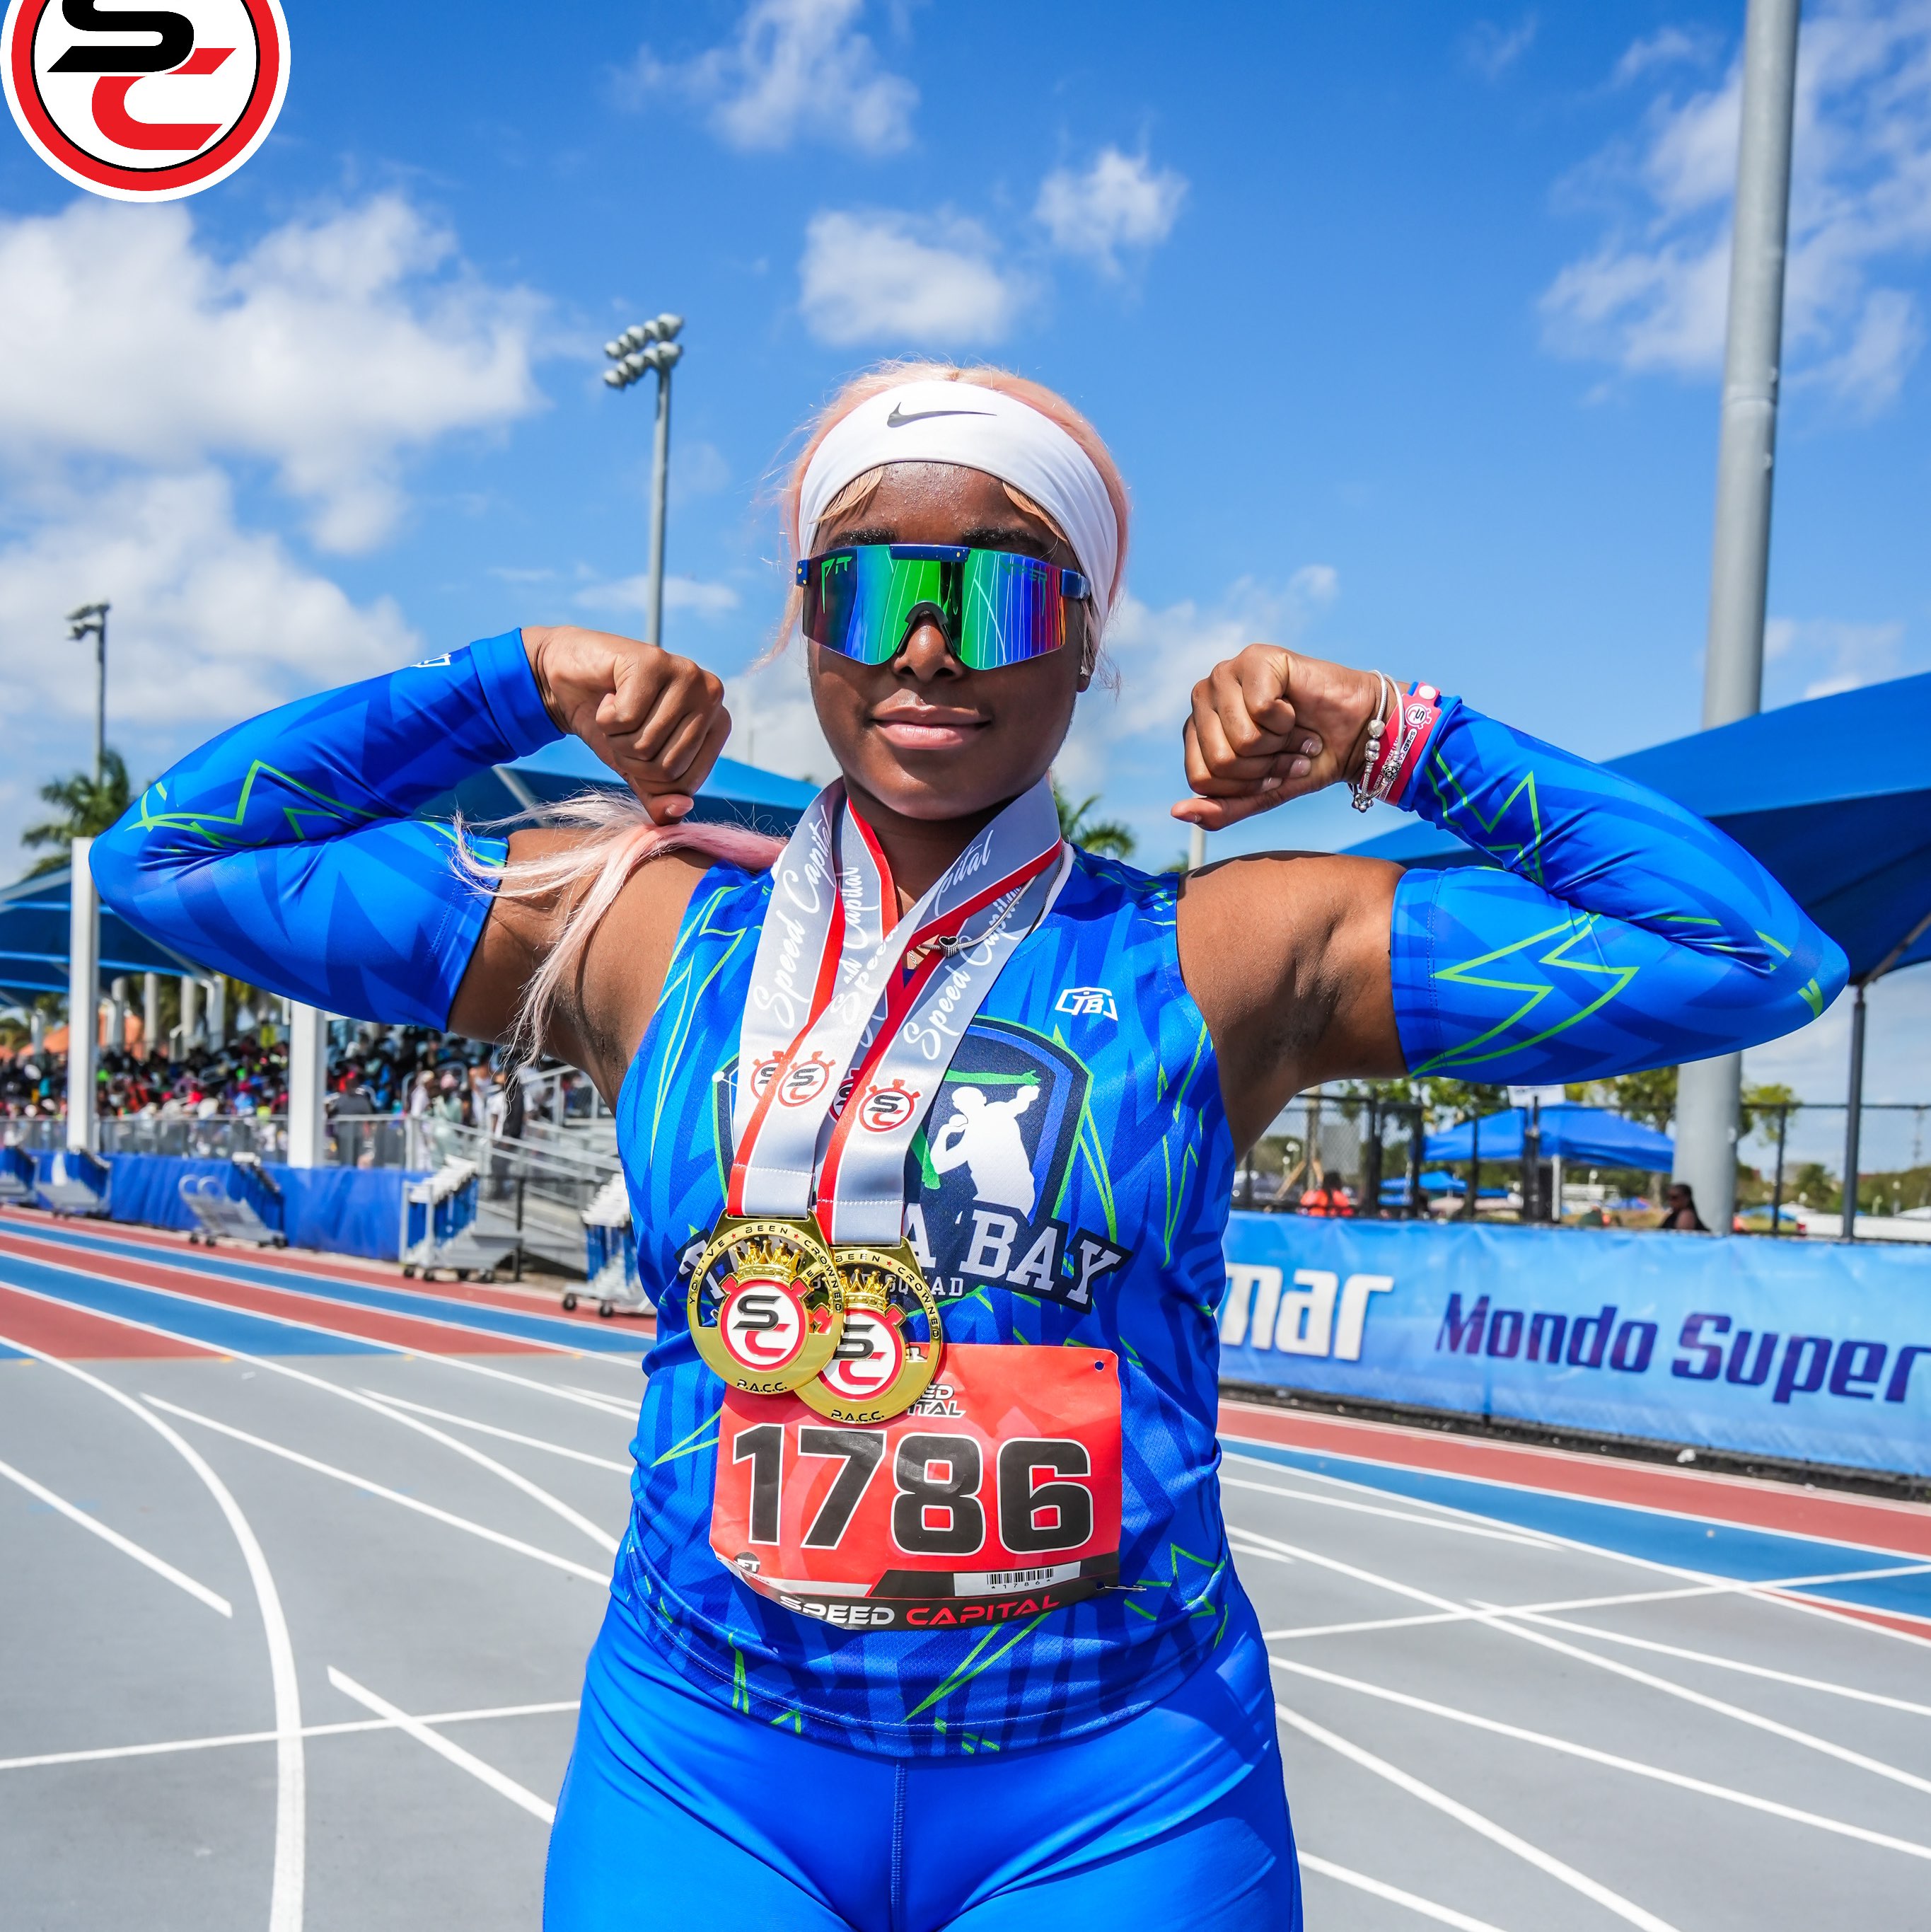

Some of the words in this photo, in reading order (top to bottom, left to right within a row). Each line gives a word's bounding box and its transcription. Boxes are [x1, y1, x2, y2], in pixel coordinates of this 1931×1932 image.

[934, 829, 994, 917] pital
[753, 909, 810, 1029] Speed
[782, 804, 835, 914] Capital
[903, 964, 971, 1060] Speed
[745, 1225, 789, 1234] BEEN
[804, 1239, 842, 1312] CROWNED
[835, 1253, 881, 1263] BEEN
[897, 1266, 940, 1339] CROWNED
[889, 1273, 965, 1297] SQAD
[959, 1208, 1125, 1304] BAY
[732, 1295, 791, 1358] SC
[1437, 1292, 1659, 1373] Mondo
[908, 1399, 966, 1418] ITAL
[731, 1421, 1094, 1556] 1786
[779, 1595, 895, 1626] SPEED
[905, 1595, 1060, 1626] CAPITAL
